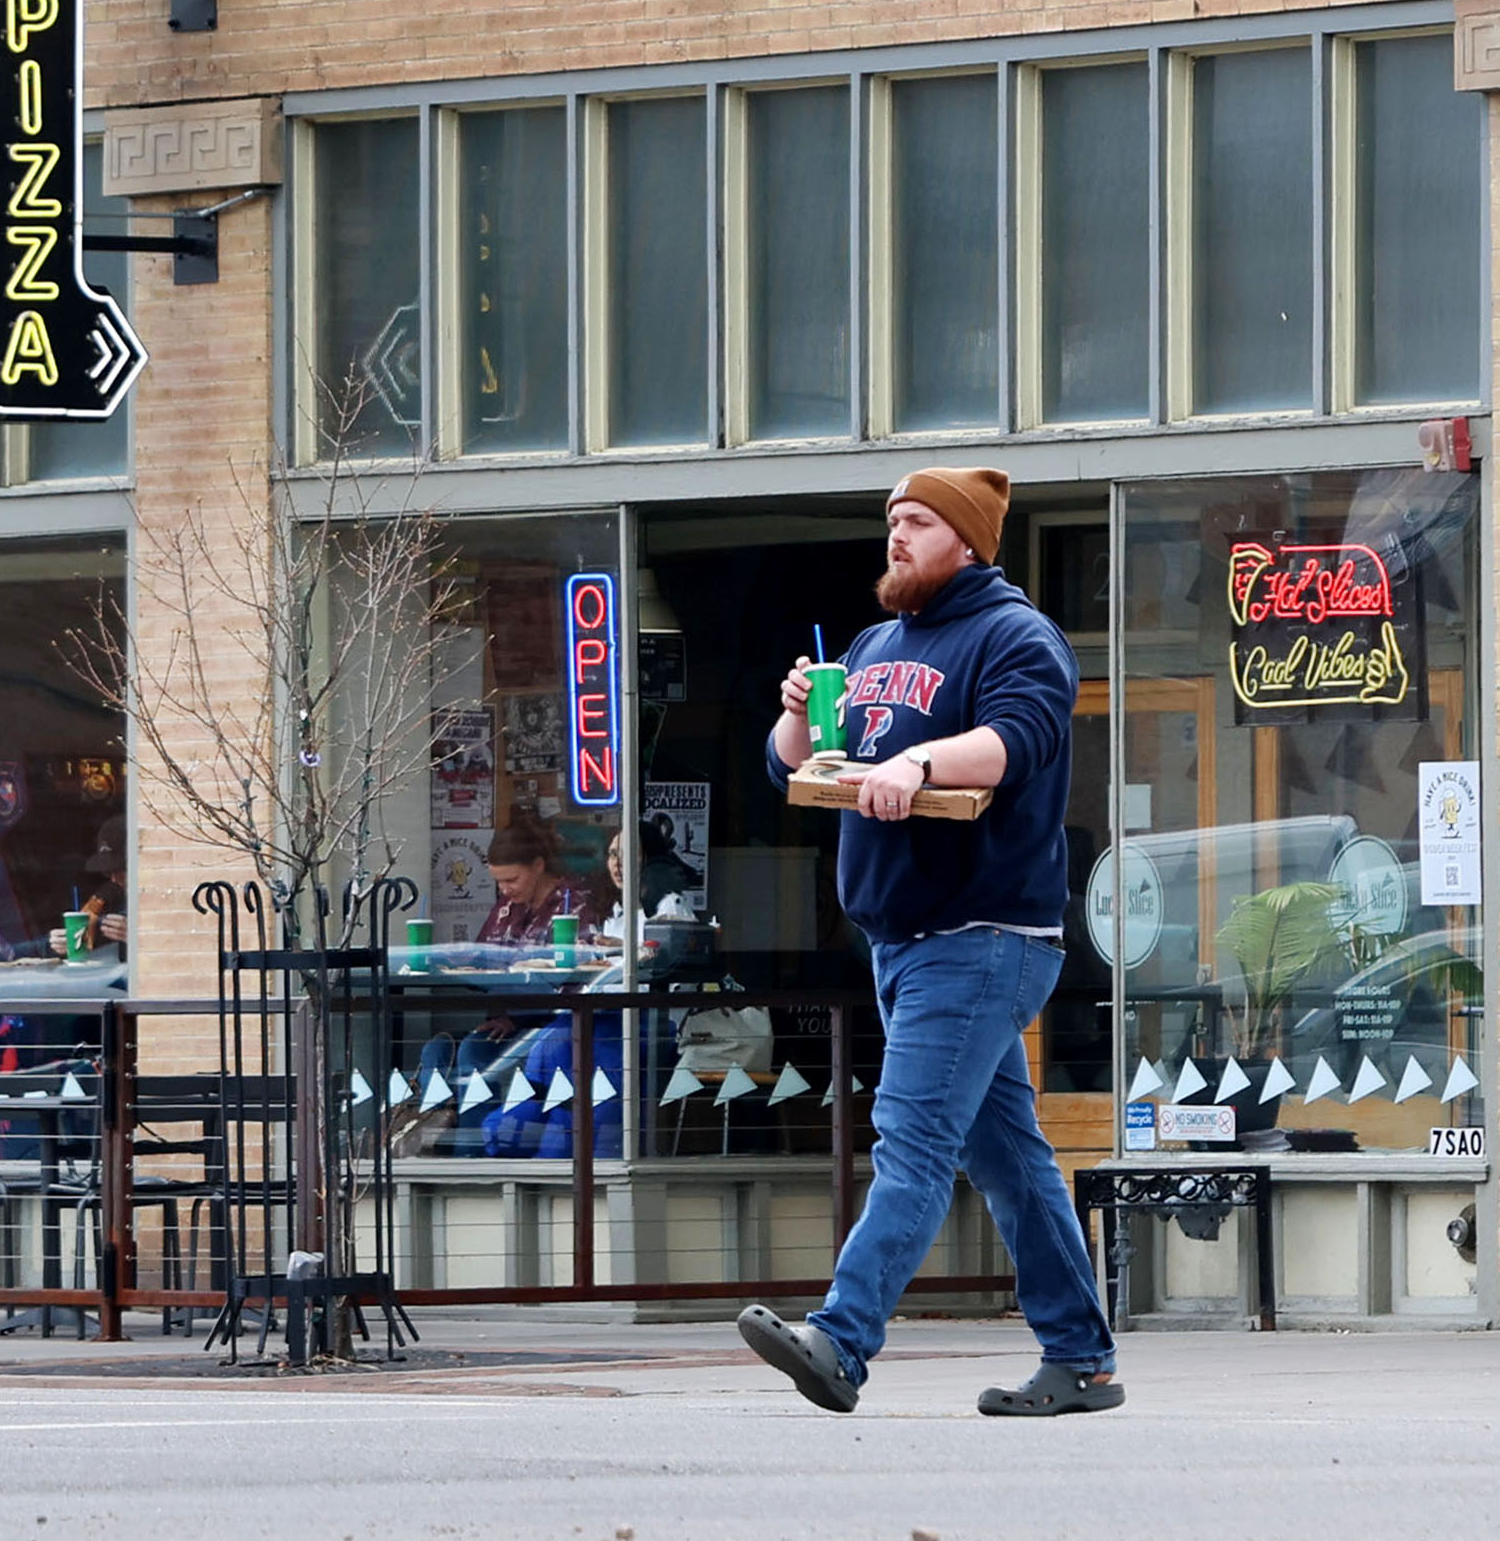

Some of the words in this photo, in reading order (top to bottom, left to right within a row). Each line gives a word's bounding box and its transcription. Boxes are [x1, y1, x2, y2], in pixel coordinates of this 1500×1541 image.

[1251, 558, 1320, 622] Hot
[1307, 559, 1384, 623] Slices
[1242, 635, 1309, 697] Cool
[1304, 631, 1365, 690] Vibes
[574, 584, 612, 793] OPEN
[856, 706, 894, 757] P
[645, 797, 707, 810] OCALIZED
[1095, 889, 1114, 916] Luc
[1128, 888, 1154, 916] Slice
[1127, 1114, 1153, 1127] Recycle
[1175, 1112, 1186, 1126] NO
[1187, 1112, 1218, 1126] SMOKING
